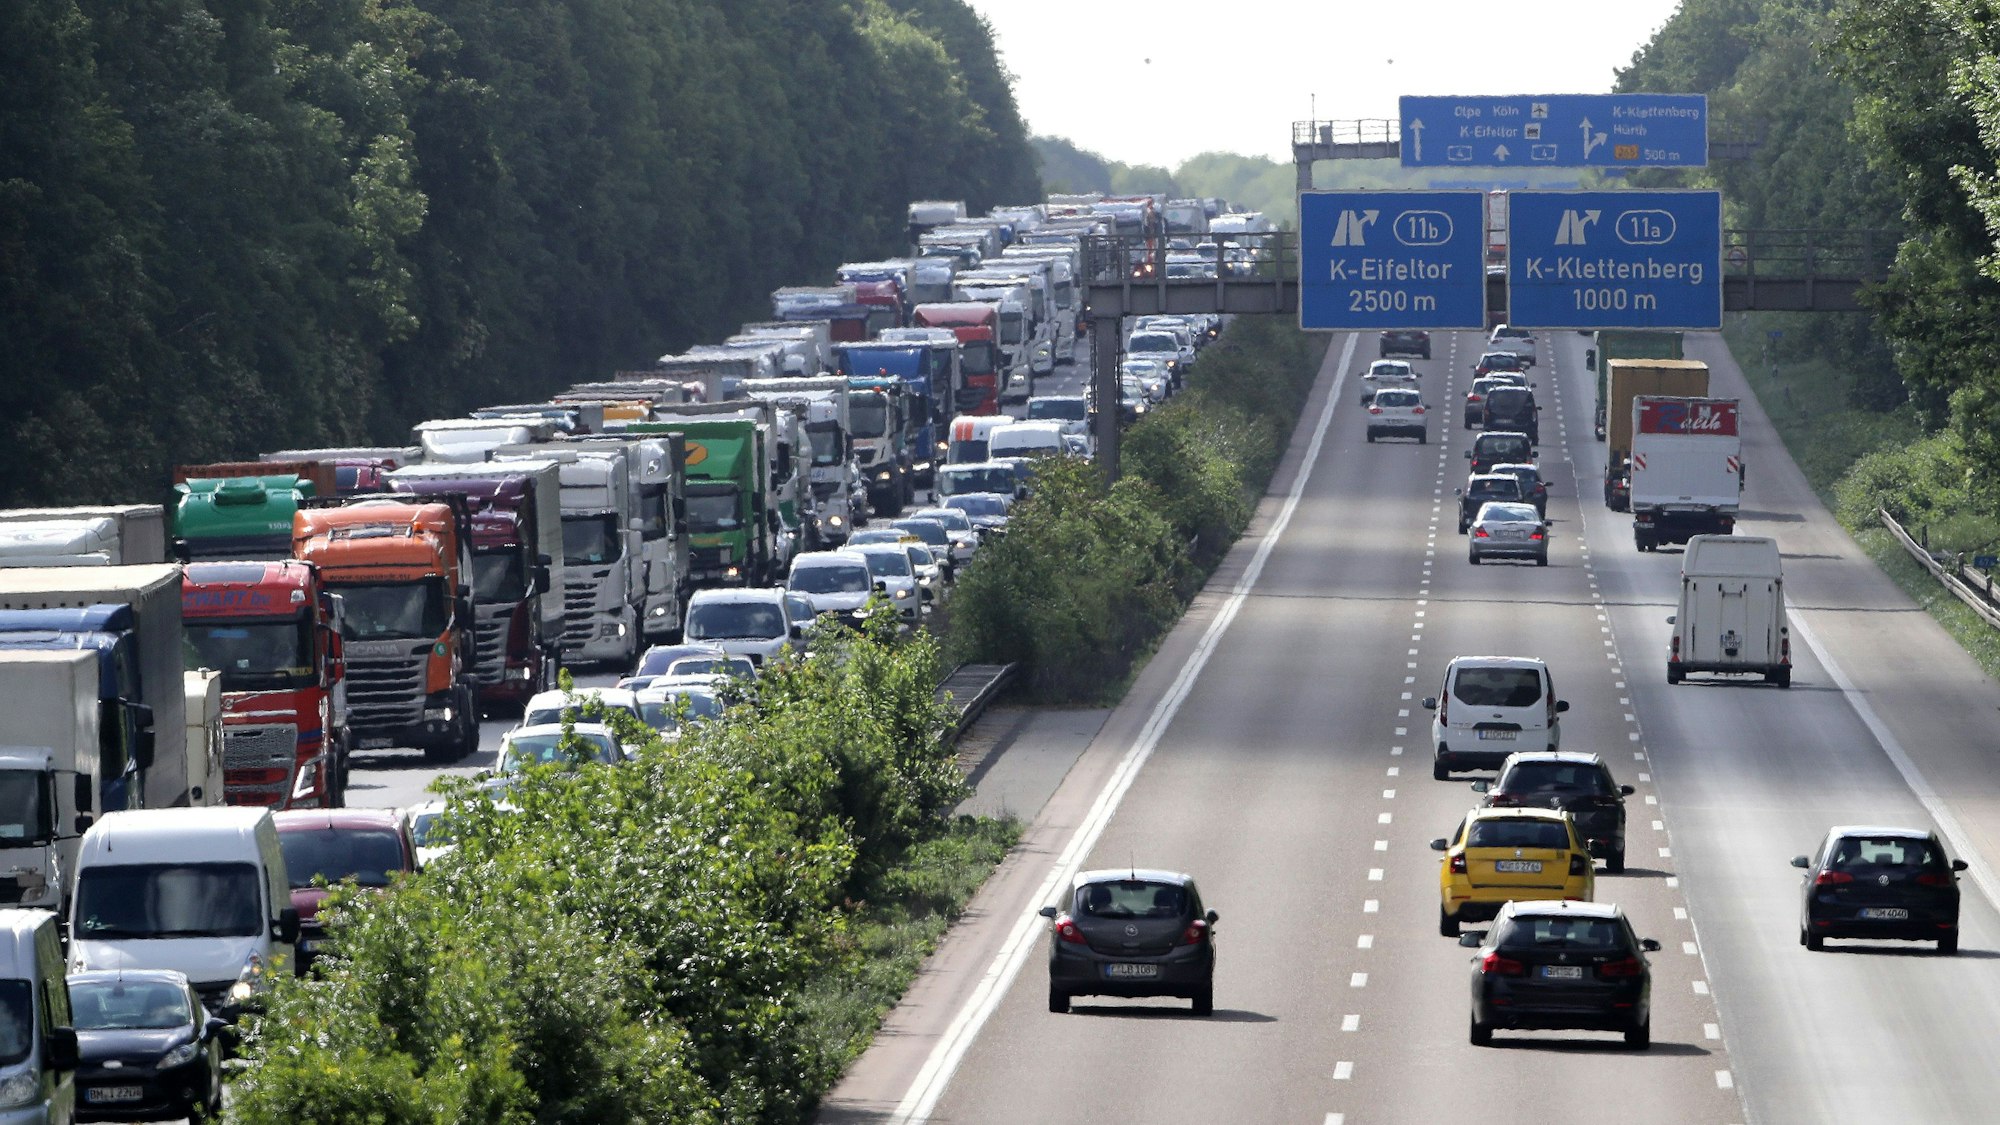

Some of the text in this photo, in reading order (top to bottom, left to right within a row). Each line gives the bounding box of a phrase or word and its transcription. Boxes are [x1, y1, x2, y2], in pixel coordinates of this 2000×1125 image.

[1613, 106, 1700, 120] K-Klettenberg
[1460, 125, 1518, 138] K-Eifeltor
[1644, 149, 1680, 161] 500 m
[1408, 216, 1439, 239] 11b
[1631, 217, 1661, 238] 11a
[1330, 258, 1453, 281] K-Eifeltor
[1526, 257, 1703, 285] K-Klettenberg
[1349, 289, 1436, 312] 2500 m
[1573, 288, 1657, 310] 1000 m
